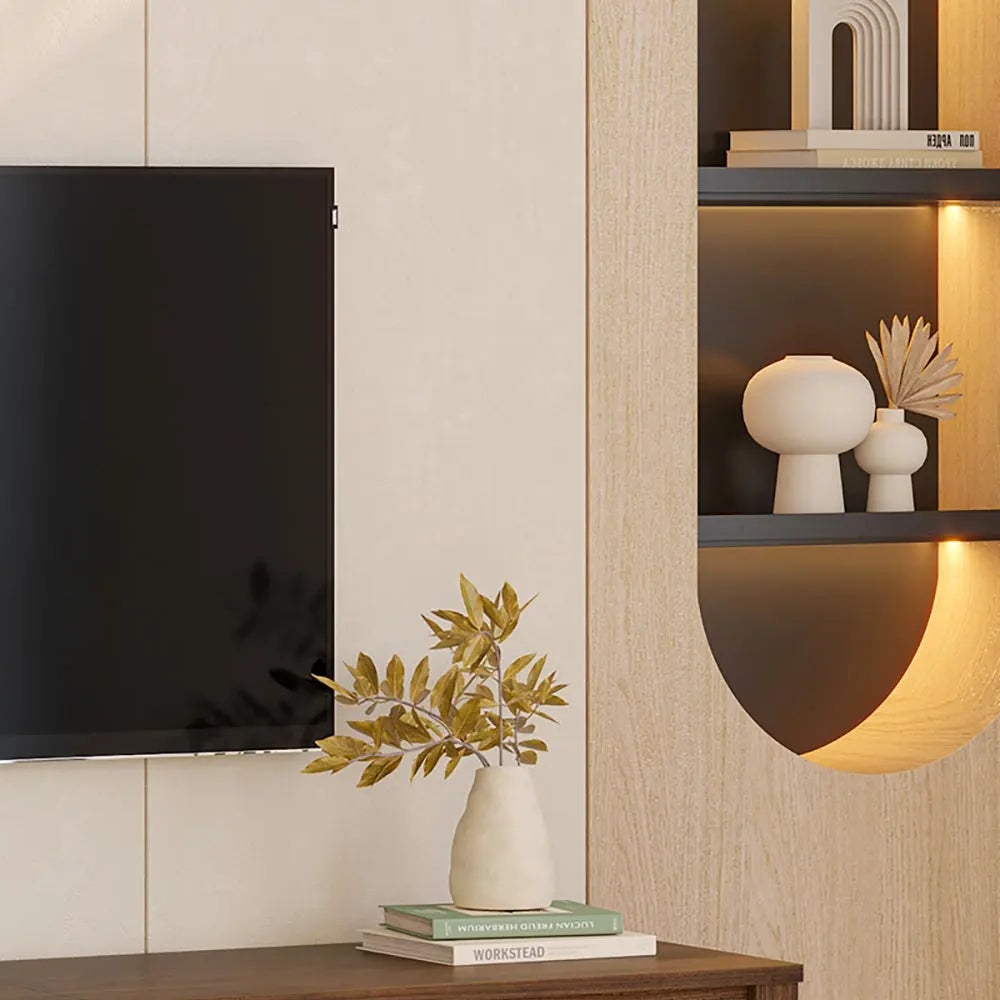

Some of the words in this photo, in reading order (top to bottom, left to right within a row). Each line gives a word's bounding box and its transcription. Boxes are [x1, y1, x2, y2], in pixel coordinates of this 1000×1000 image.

[457, 923, 518, 933] HERBARIUM
[521, 921, 554, 931] FREUD
[556, 920, 594, 929] LUCIAN
[473, 946, 545, 961] WORKSTEAD
